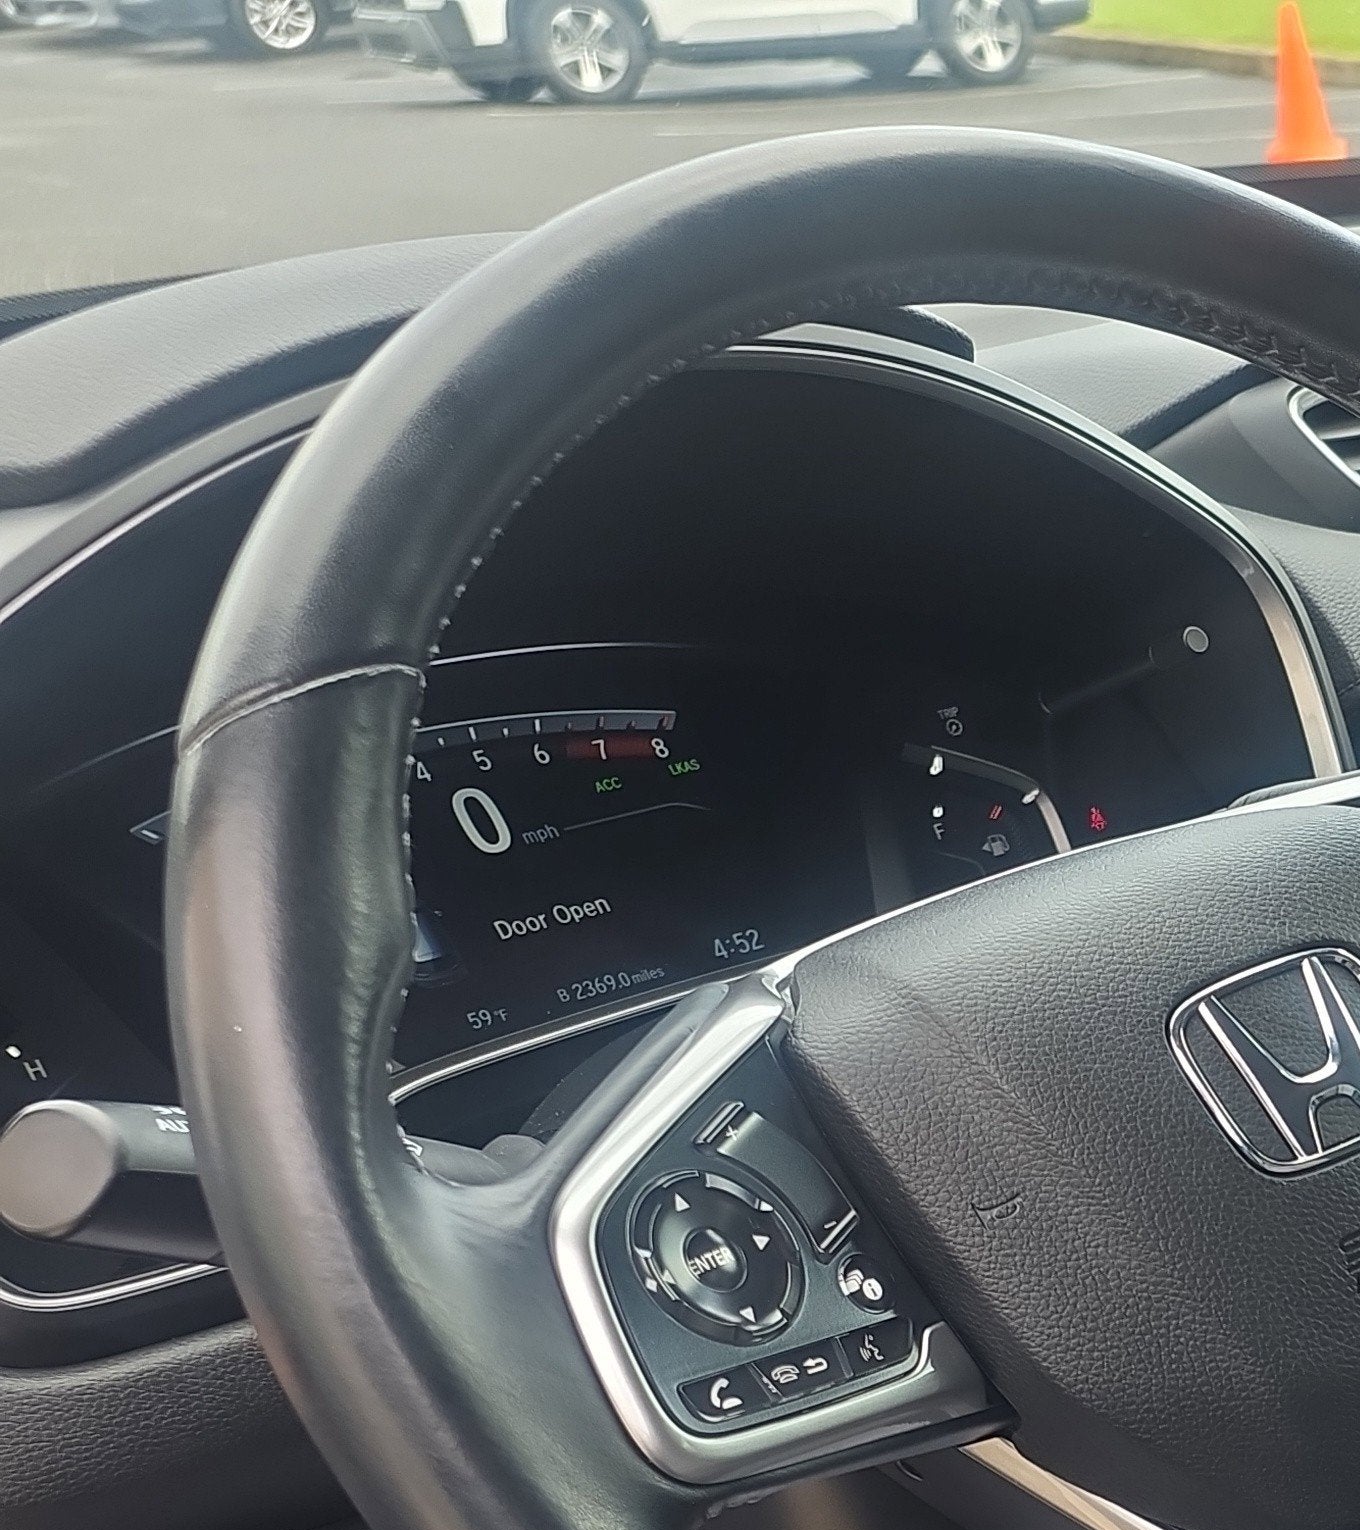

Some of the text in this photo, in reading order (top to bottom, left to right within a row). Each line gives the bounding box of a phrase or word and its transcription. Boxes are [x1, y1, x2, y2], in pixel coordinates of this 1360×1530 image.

[937, 706, 960, 720] TRIP
[415, 738, 669, 783] 4 5 6 7 8
[668, 758, 701, 777] LKAS
[594, 776, 623, 794] ACC
[451, 787, 561, 854] 0 mph
[932, 822, 946, 841] F
[493, 897, 612, 941] Door Open
[713, 928, 766, 960] 4:52
[556, 987, 571, 1003] B
[23, 1058, 48, 1081] H
[689, 1244, 736, 1278] ENTER
